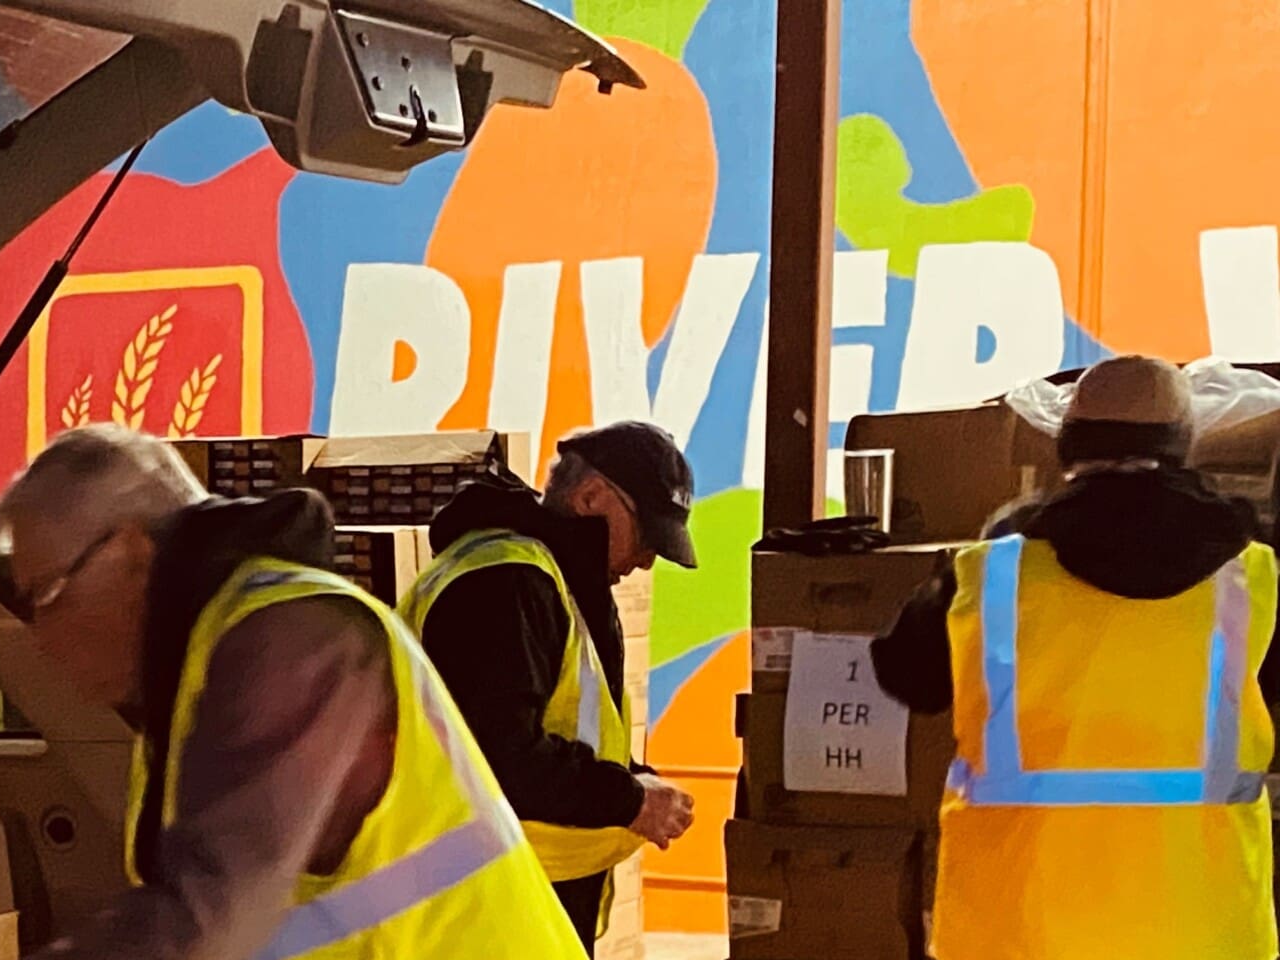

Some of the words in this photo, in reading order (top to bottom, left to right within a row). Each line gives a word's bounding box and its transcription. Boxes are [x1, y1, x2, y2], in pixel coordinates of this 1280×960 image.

[846, 661, 859, 682] 1
[822, 703, 870, 725] PER
[825, 747, 862, 768] HH
